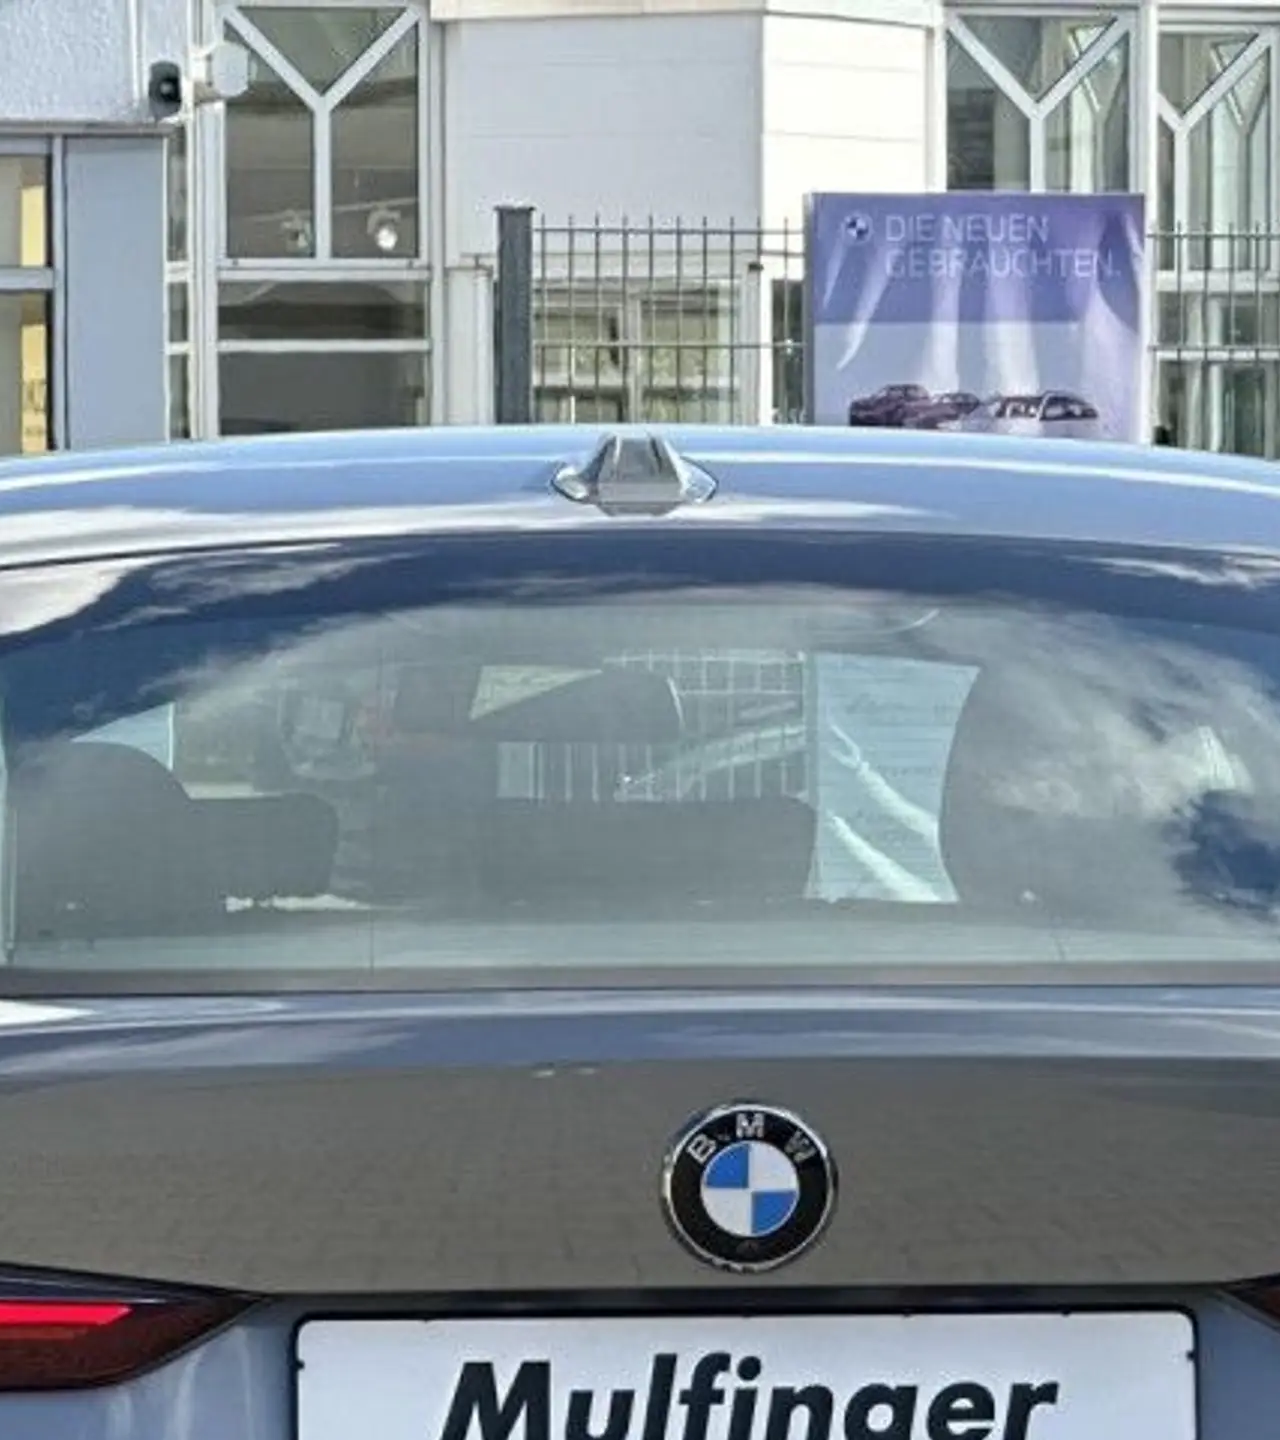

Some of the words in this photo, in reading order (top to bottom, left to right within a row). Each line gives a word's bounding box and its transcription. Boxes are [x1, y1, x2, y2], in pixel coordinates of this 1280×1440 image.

[885, 212, 934, 243] DIE
[942, 212, 1049, 243] NEUEN
[685, 1112, 817, 1165] BMW
